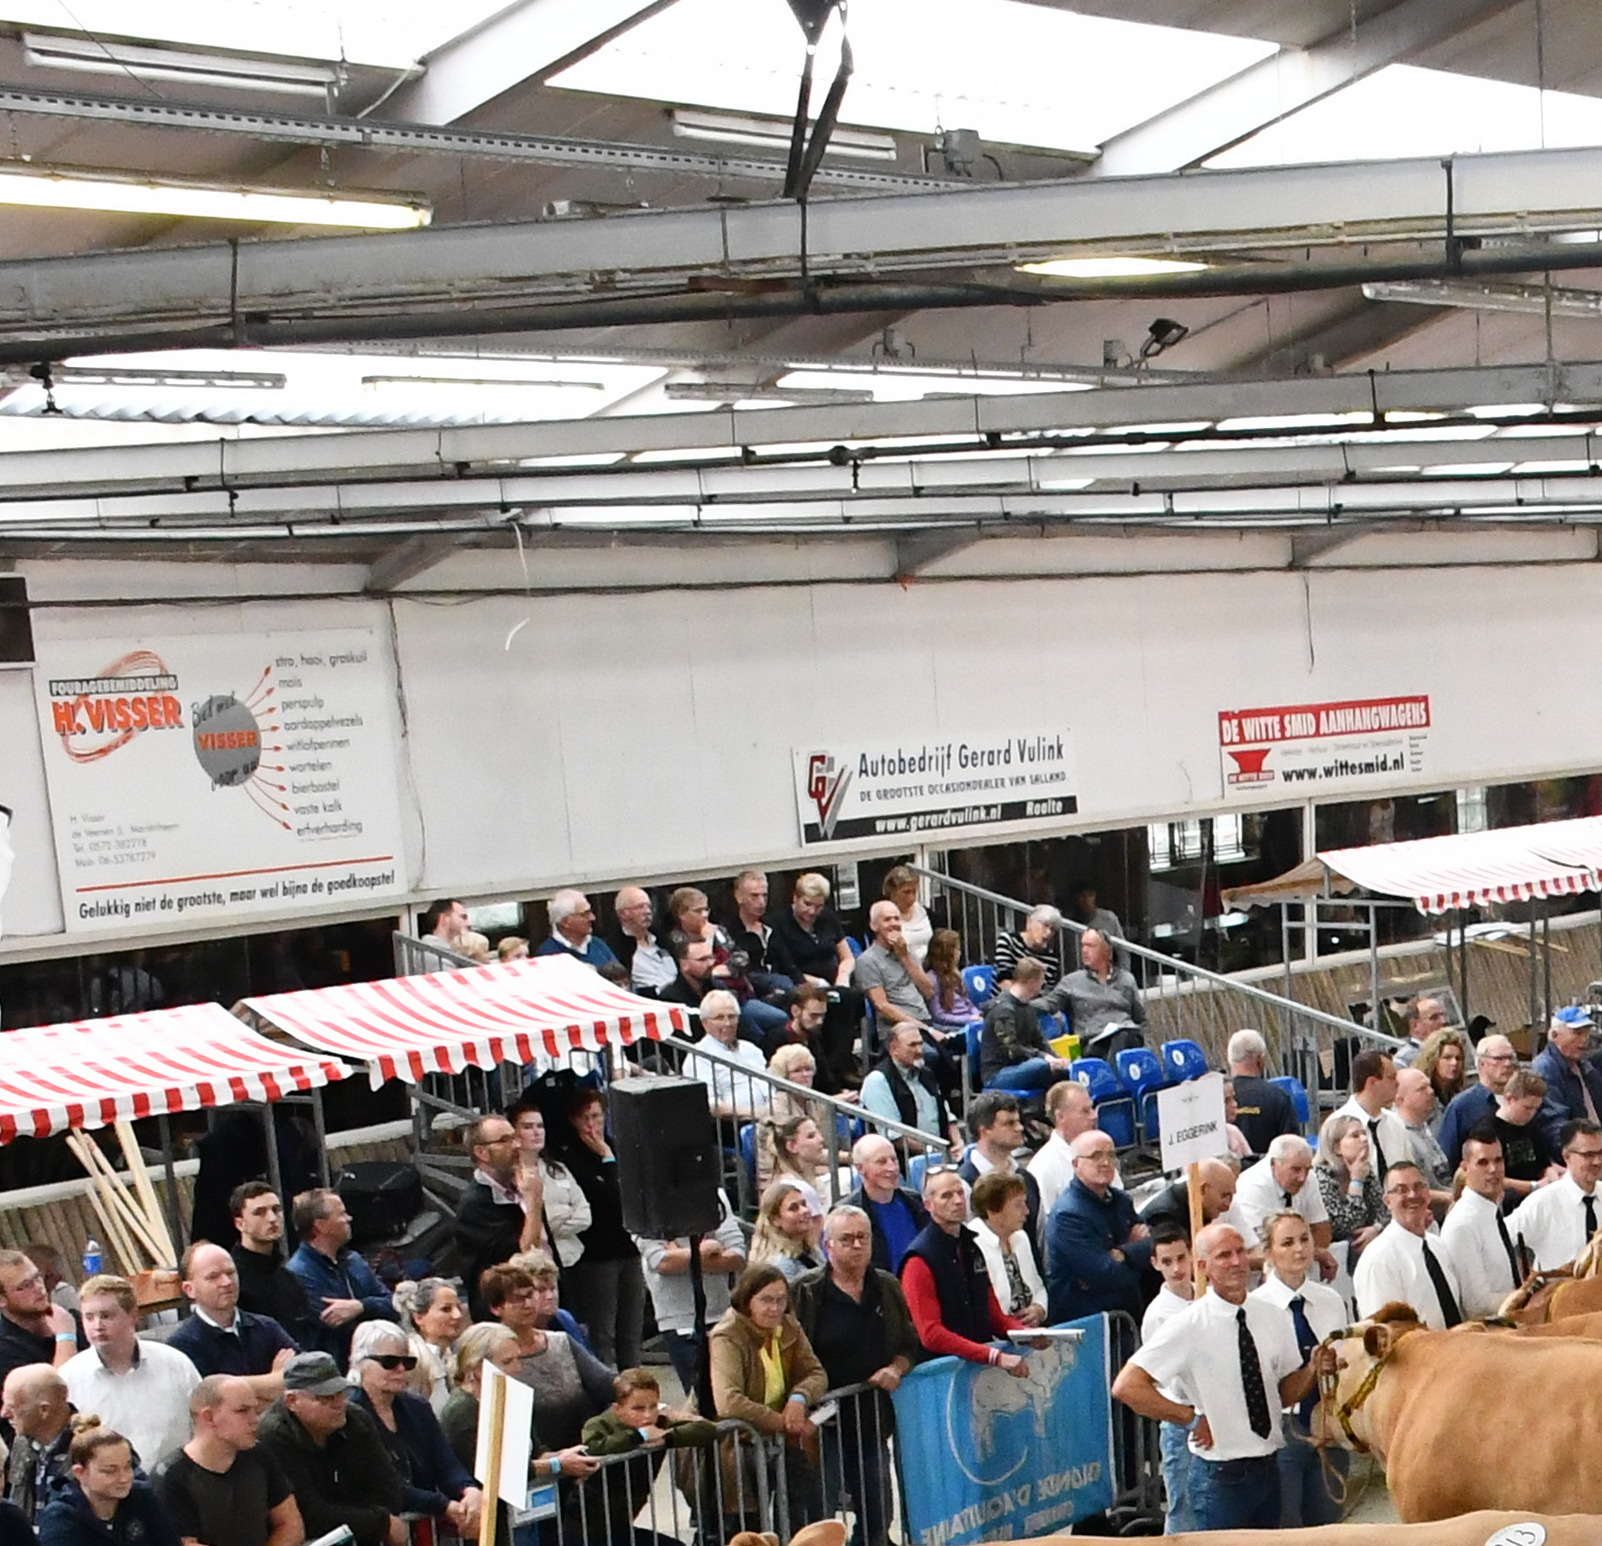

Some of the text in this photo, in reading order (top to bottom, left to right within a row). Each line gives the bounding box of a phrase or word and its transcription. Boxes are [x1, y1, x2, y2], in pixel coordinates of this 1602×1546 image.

[51, 678, 178, 695] FOURAGEBEMIDDELING
[1221, 702, 1427, 744] DE WITTE SMID AANHANGWAGENS
[197, 731, 258, 750] VISSER
[859, 734, 1064, 779] Autobedrijf Gerard Vulink
[1282, 751, 1404, 782] www.wittesmid.nl
[860, 771, 1066, 802] DE GROOTSTE OCCASIONDEALER VAN SALLAND
[875, 798, 1063, 833] www.gerardvulink.nl Raalte
[79, 899, 131, 919] Gelukkig
[134, 896, 157, 914] niet
[160, 893, 174, 911] de
[177, 890, 227, 912] grootste,
[230, 888, 257, 902] maar
[260, 881, 279, 898] wel
[282, 880, 309, 899] bijna
[311, 877, 325, 894] de
[1177, 1120, 1218, 1143] EGGERINK
